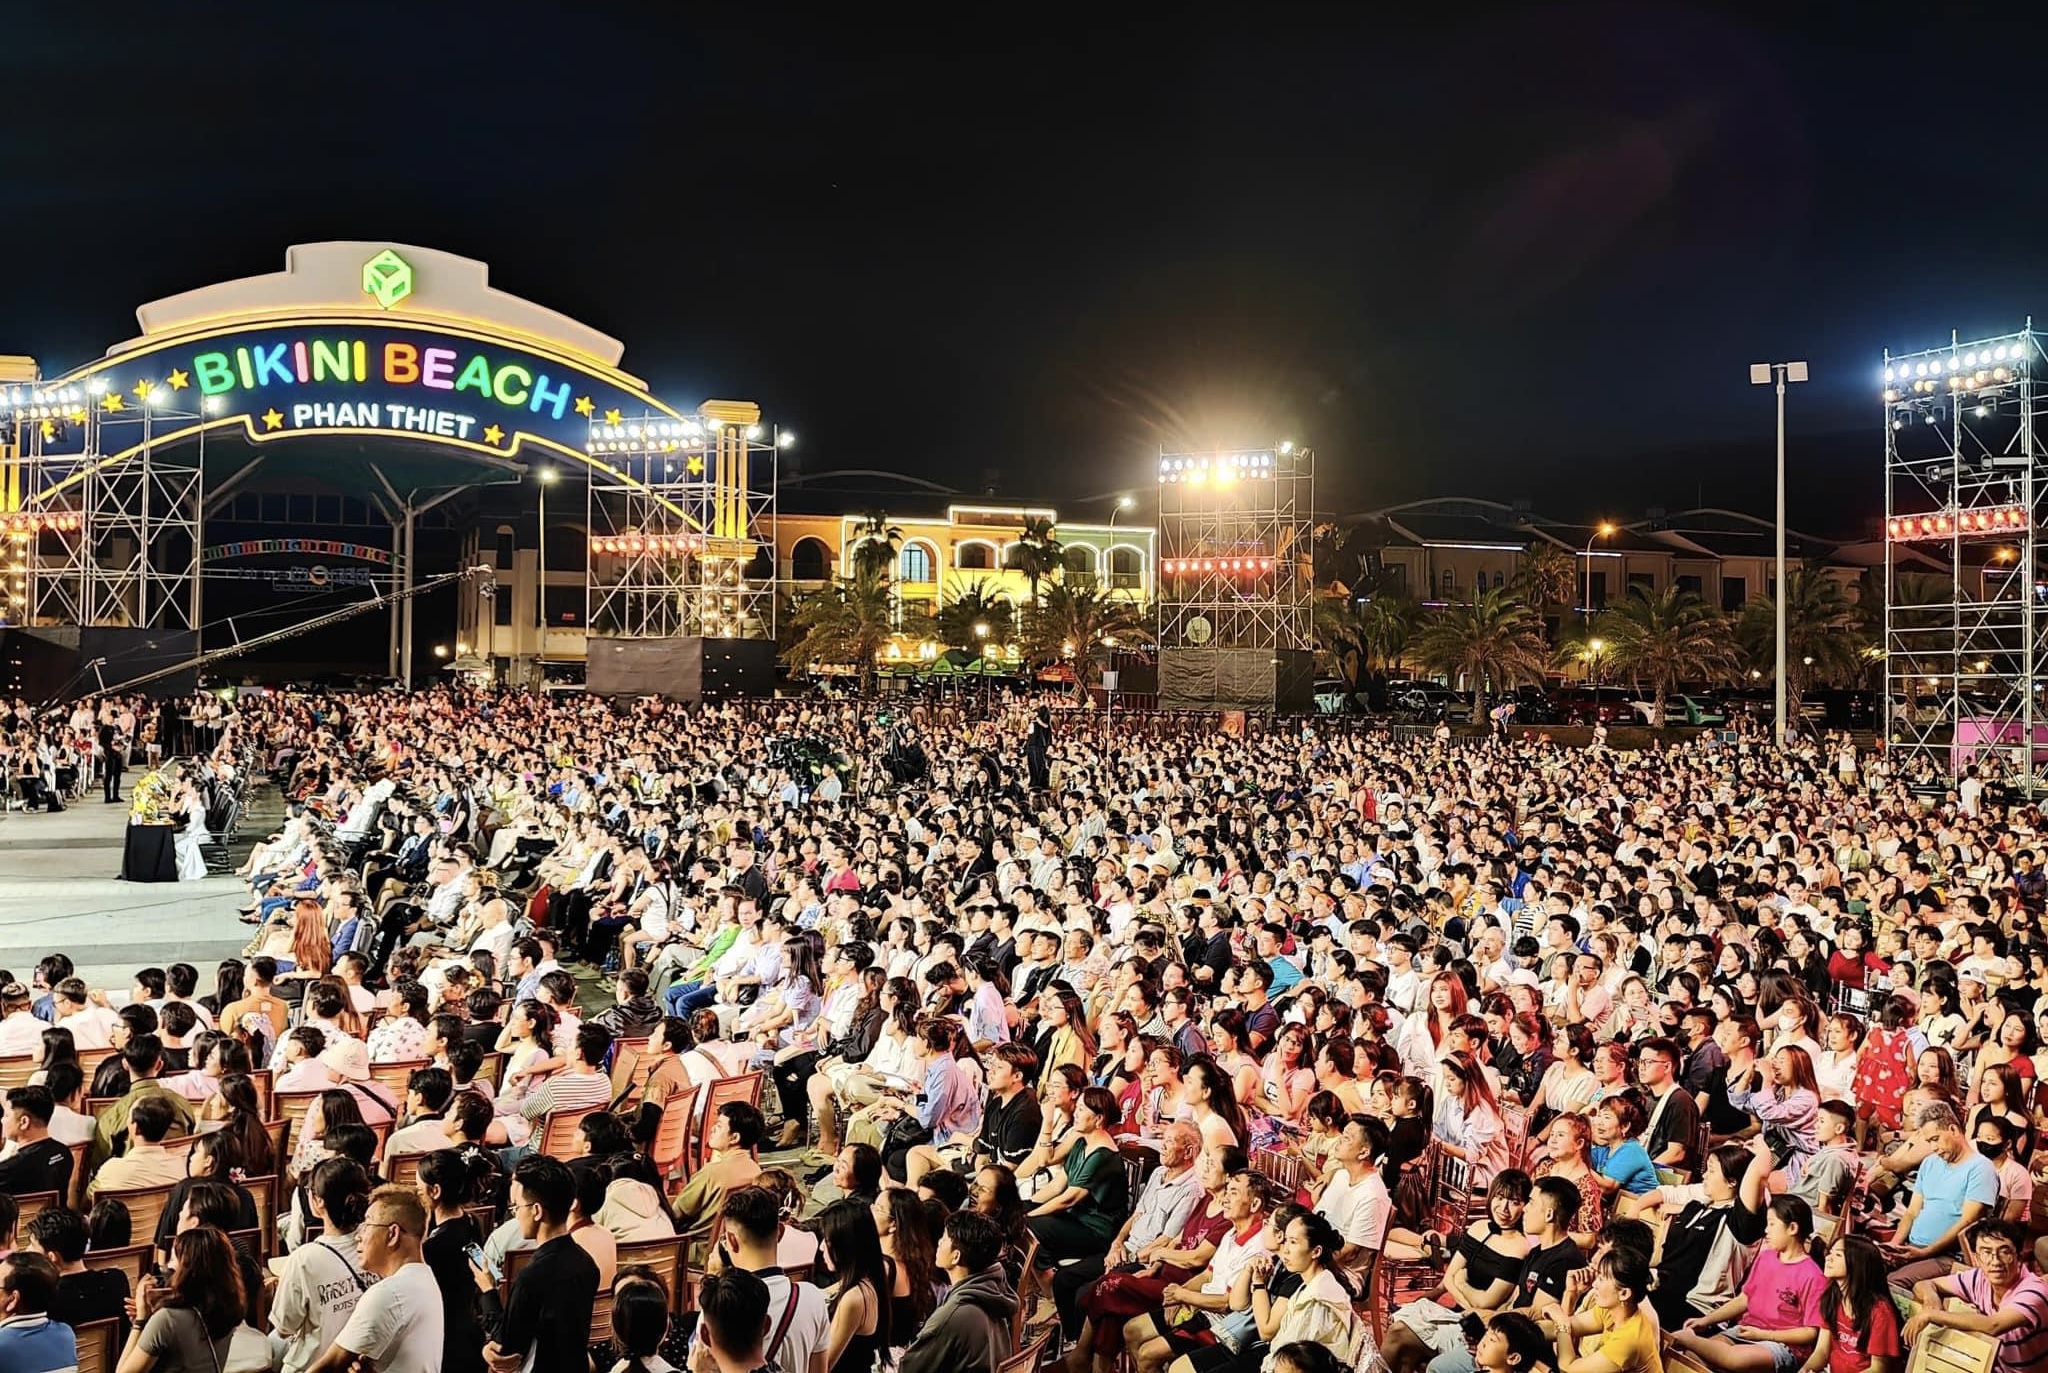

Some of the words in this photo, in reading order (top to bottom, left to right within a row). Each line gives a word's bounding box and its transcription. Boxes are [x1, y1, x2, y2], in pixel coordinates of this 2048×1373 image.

[193, 340, 367, 395] BIKINI
[384, 343, 571, 419] BEACH
[293, 402, 380, 428] PHAN
[386, 404, 476, 439] THIET
[266, 538, 321, 553] NIGHT
